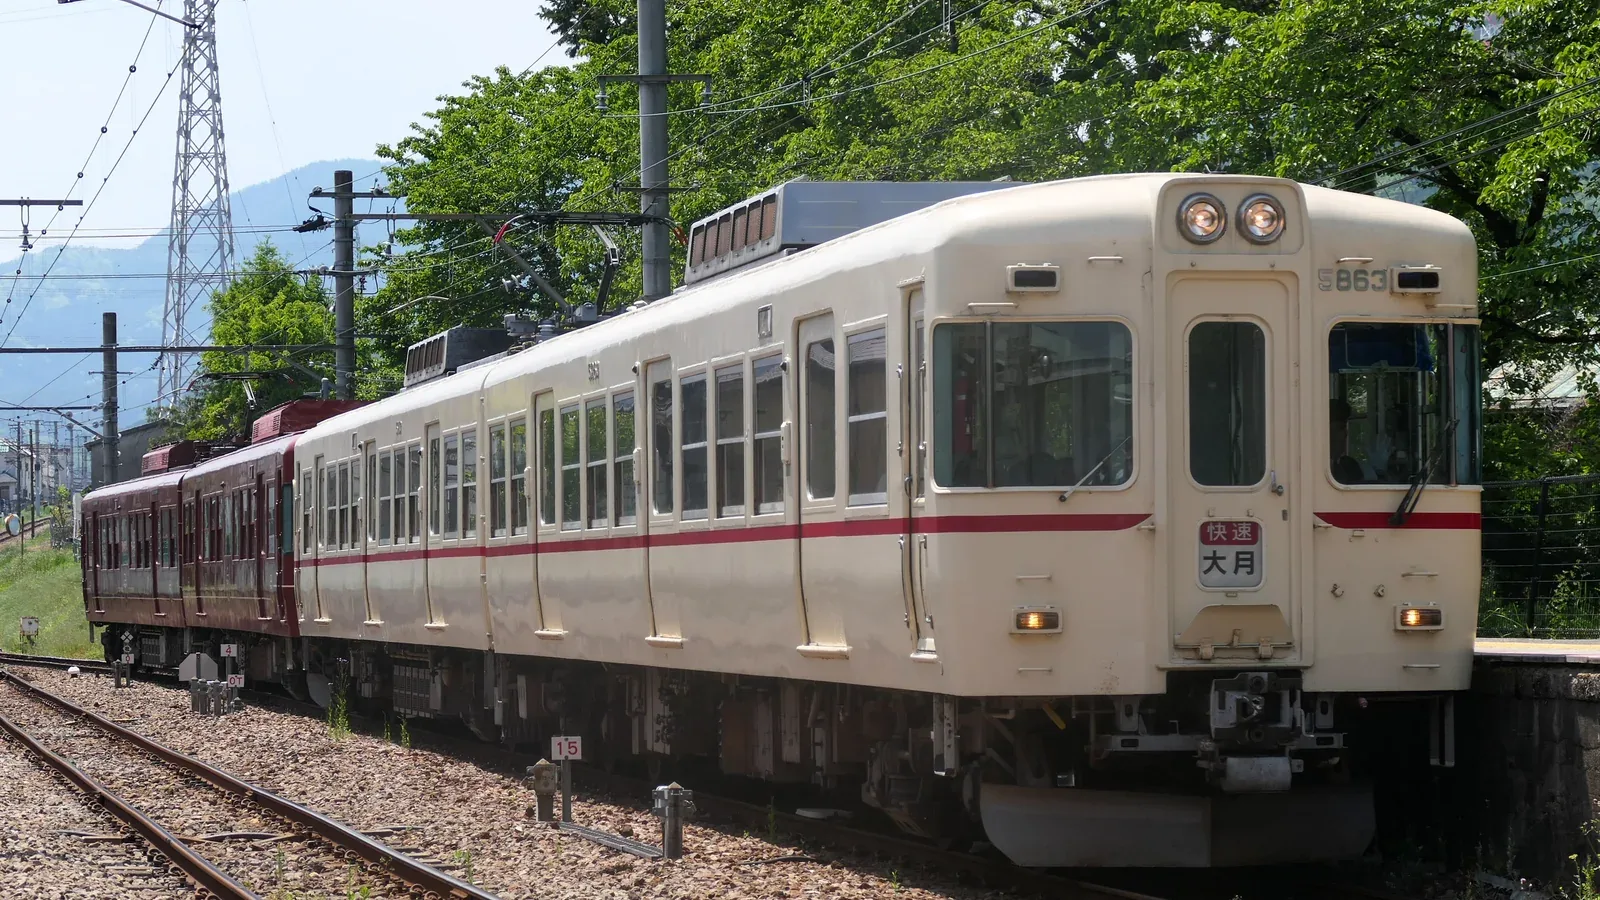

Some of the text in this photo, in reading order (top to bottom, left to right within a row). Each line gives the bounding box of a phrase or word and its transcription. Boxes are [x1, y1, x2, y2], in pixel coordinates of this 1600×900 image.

[1318, 268, 1387, 291] 5863
[1207, 522, 1252, 541] 快速
[1203, 550, 1255, 576] 大月
[557, 741, 578, 755] 15
